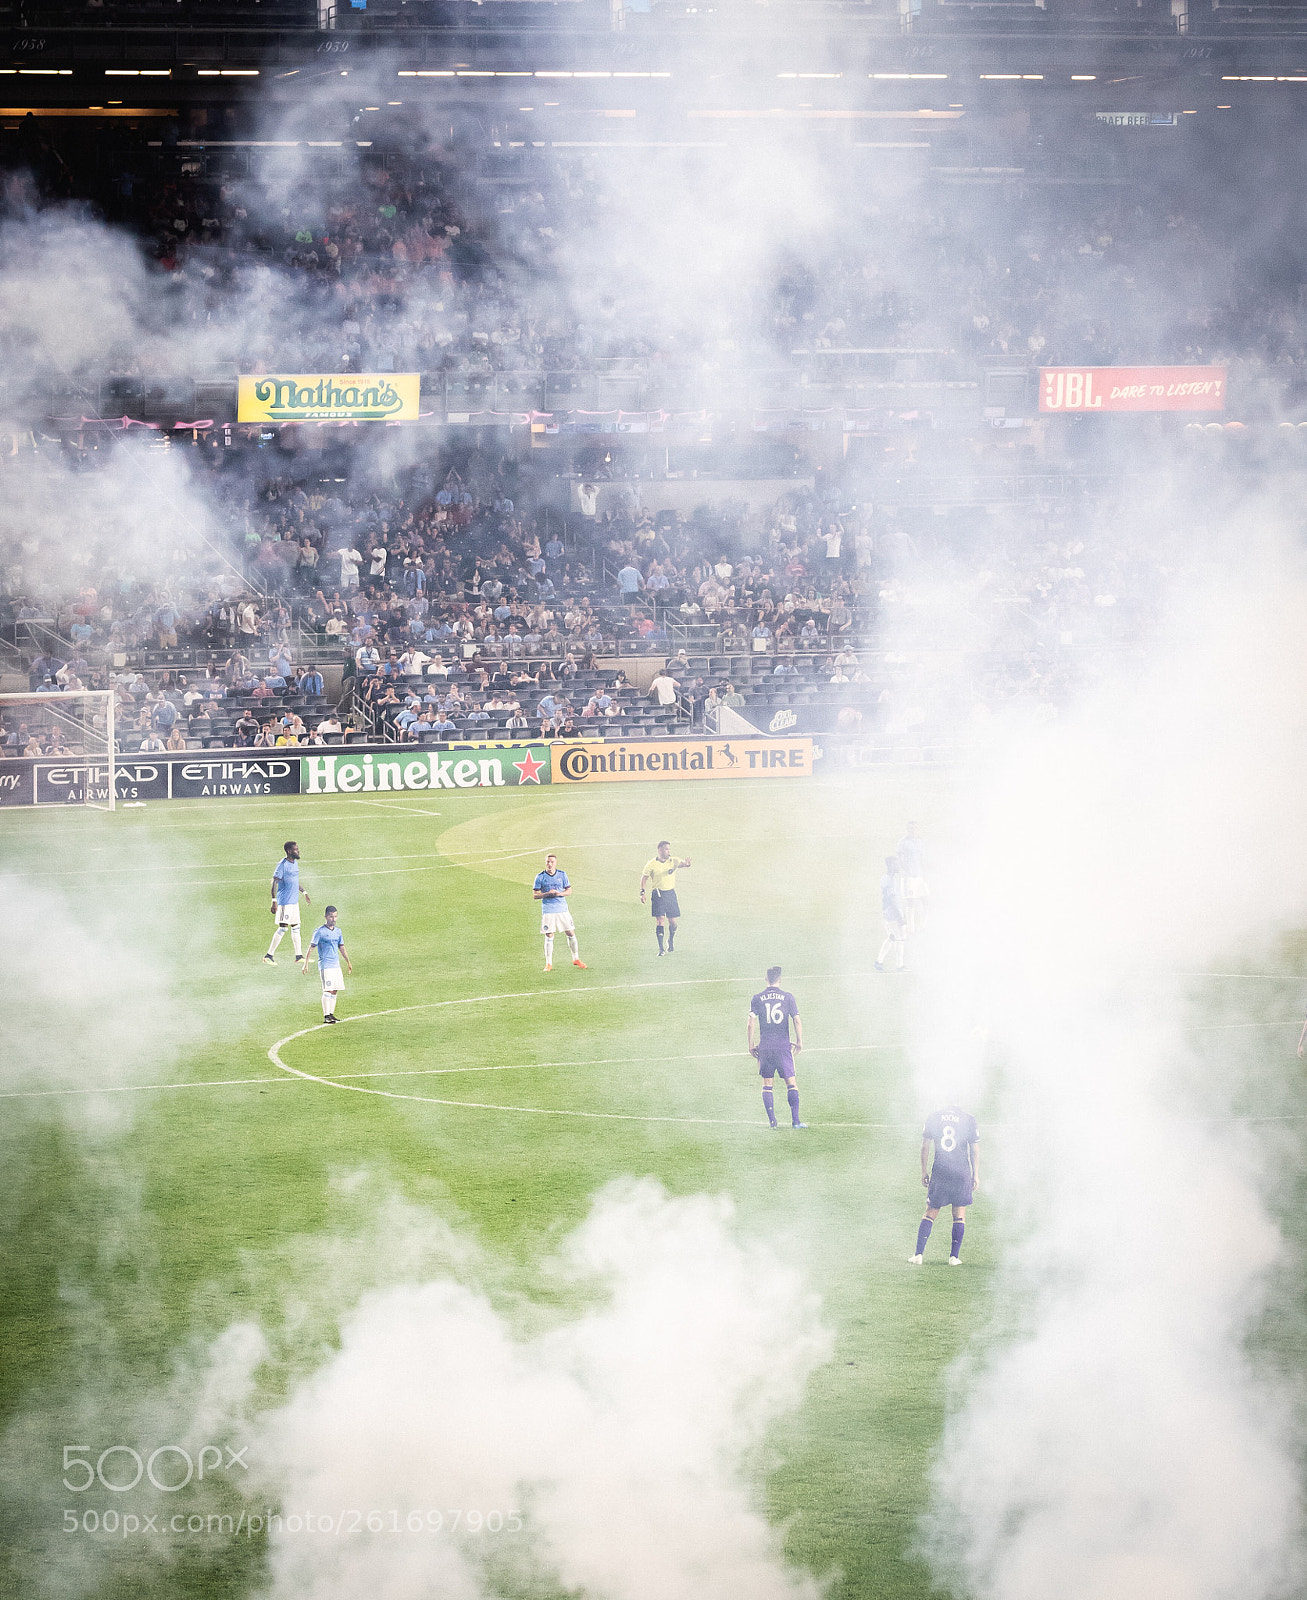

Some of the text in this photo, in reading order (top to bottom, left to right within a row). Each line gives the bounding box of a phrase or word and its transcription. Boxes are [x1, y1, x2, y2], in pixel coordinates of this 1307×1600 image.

[13, 39, 46, 50] 1938
[316, 41, 349, 52] 1939
[255, 377, 402, 409] Nathan's
[1046, 372, 1102, 408] JBL
[1110, 384, 1147, 399] DARE
[1149, 386, 1164, 396] TO
[181, 761, 291, 780] ETIHAD
[305, 752, 506, 794] Heineken
[559, 745, 714, 781] Continental
[744, 749, 805, 770] TIRE
[47, 765, 159, 785] ETIHAD
[201, 782, 271, 796] AIRWAYS
[764, 1002, 784, 1024] 16
[940, 1125, 957, 1152] 8
